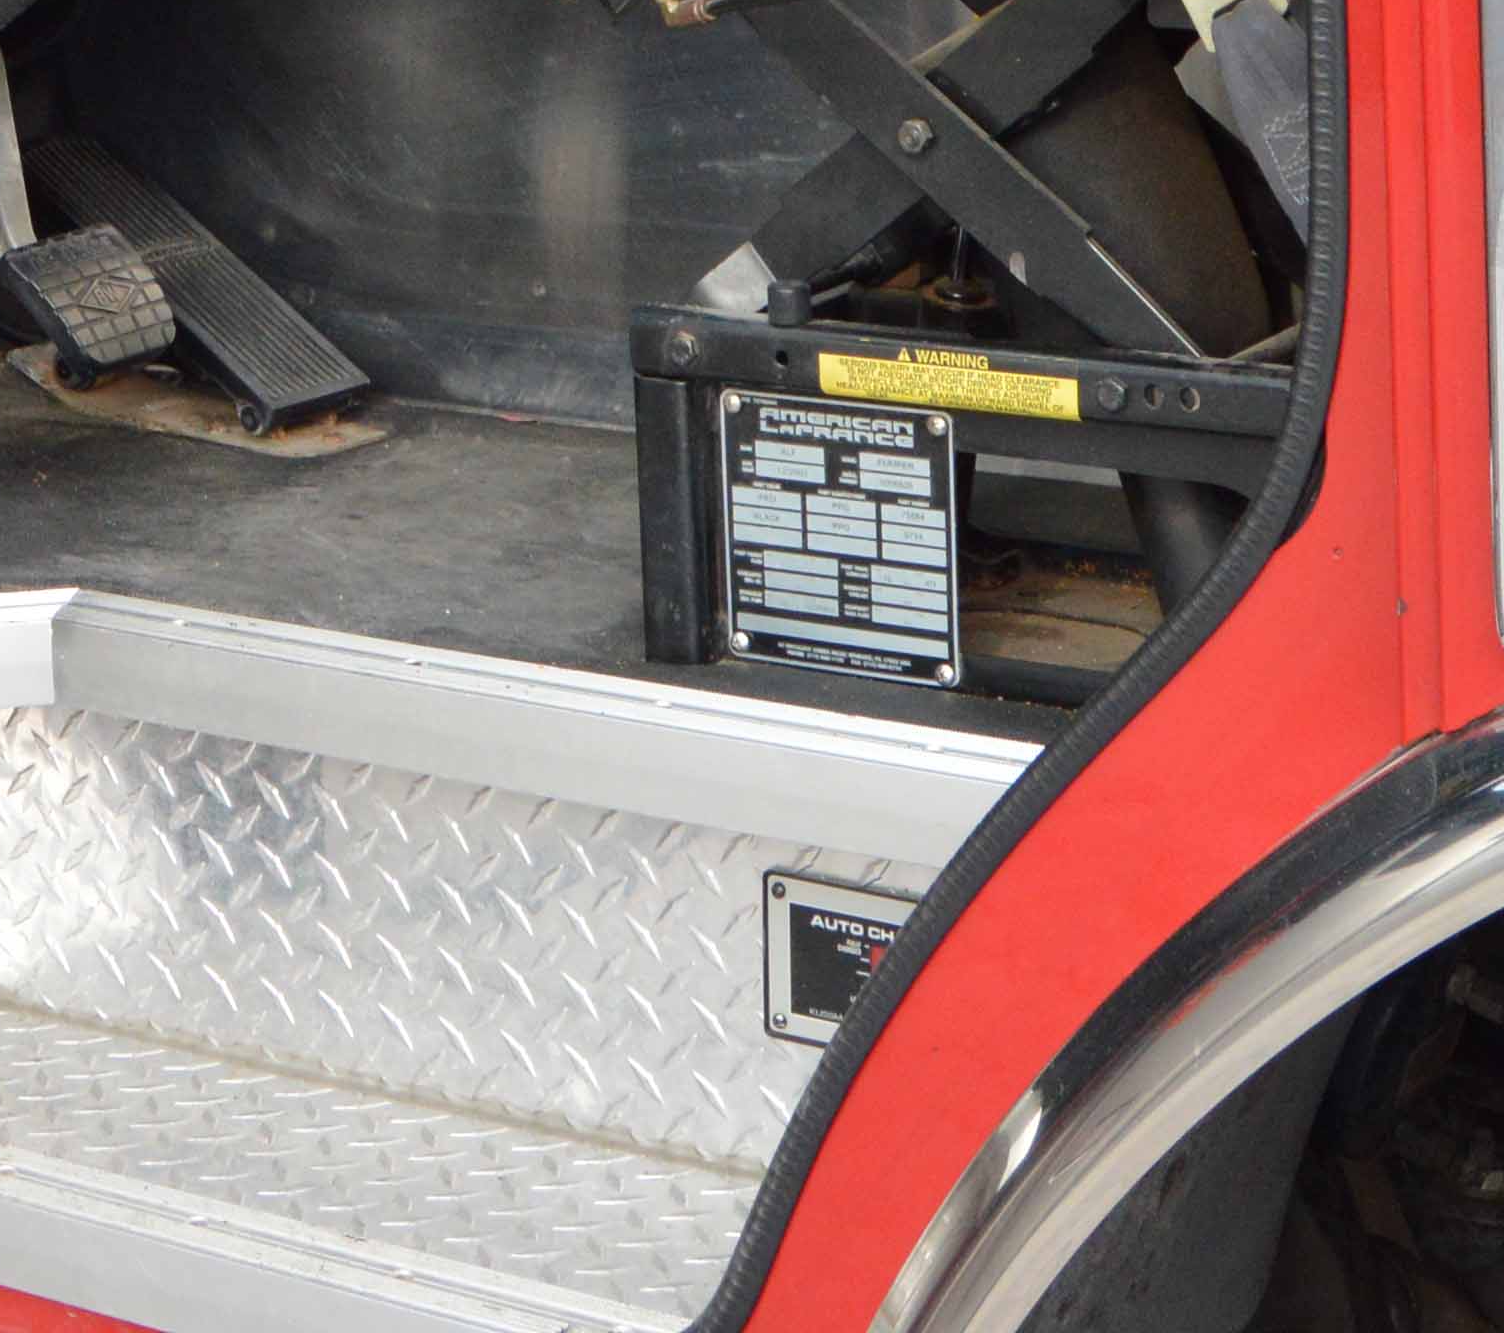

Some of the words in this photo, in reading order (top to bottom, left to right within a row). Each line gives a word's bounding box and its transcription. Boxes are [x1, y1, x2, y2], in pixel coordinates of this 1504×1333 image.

[914, 348, 990, 371] WARNING
[759, 406, 914, 435] AMERICAN
[810, 914, 865, 937] AUTO
[867, 925, 896, 943] CH
